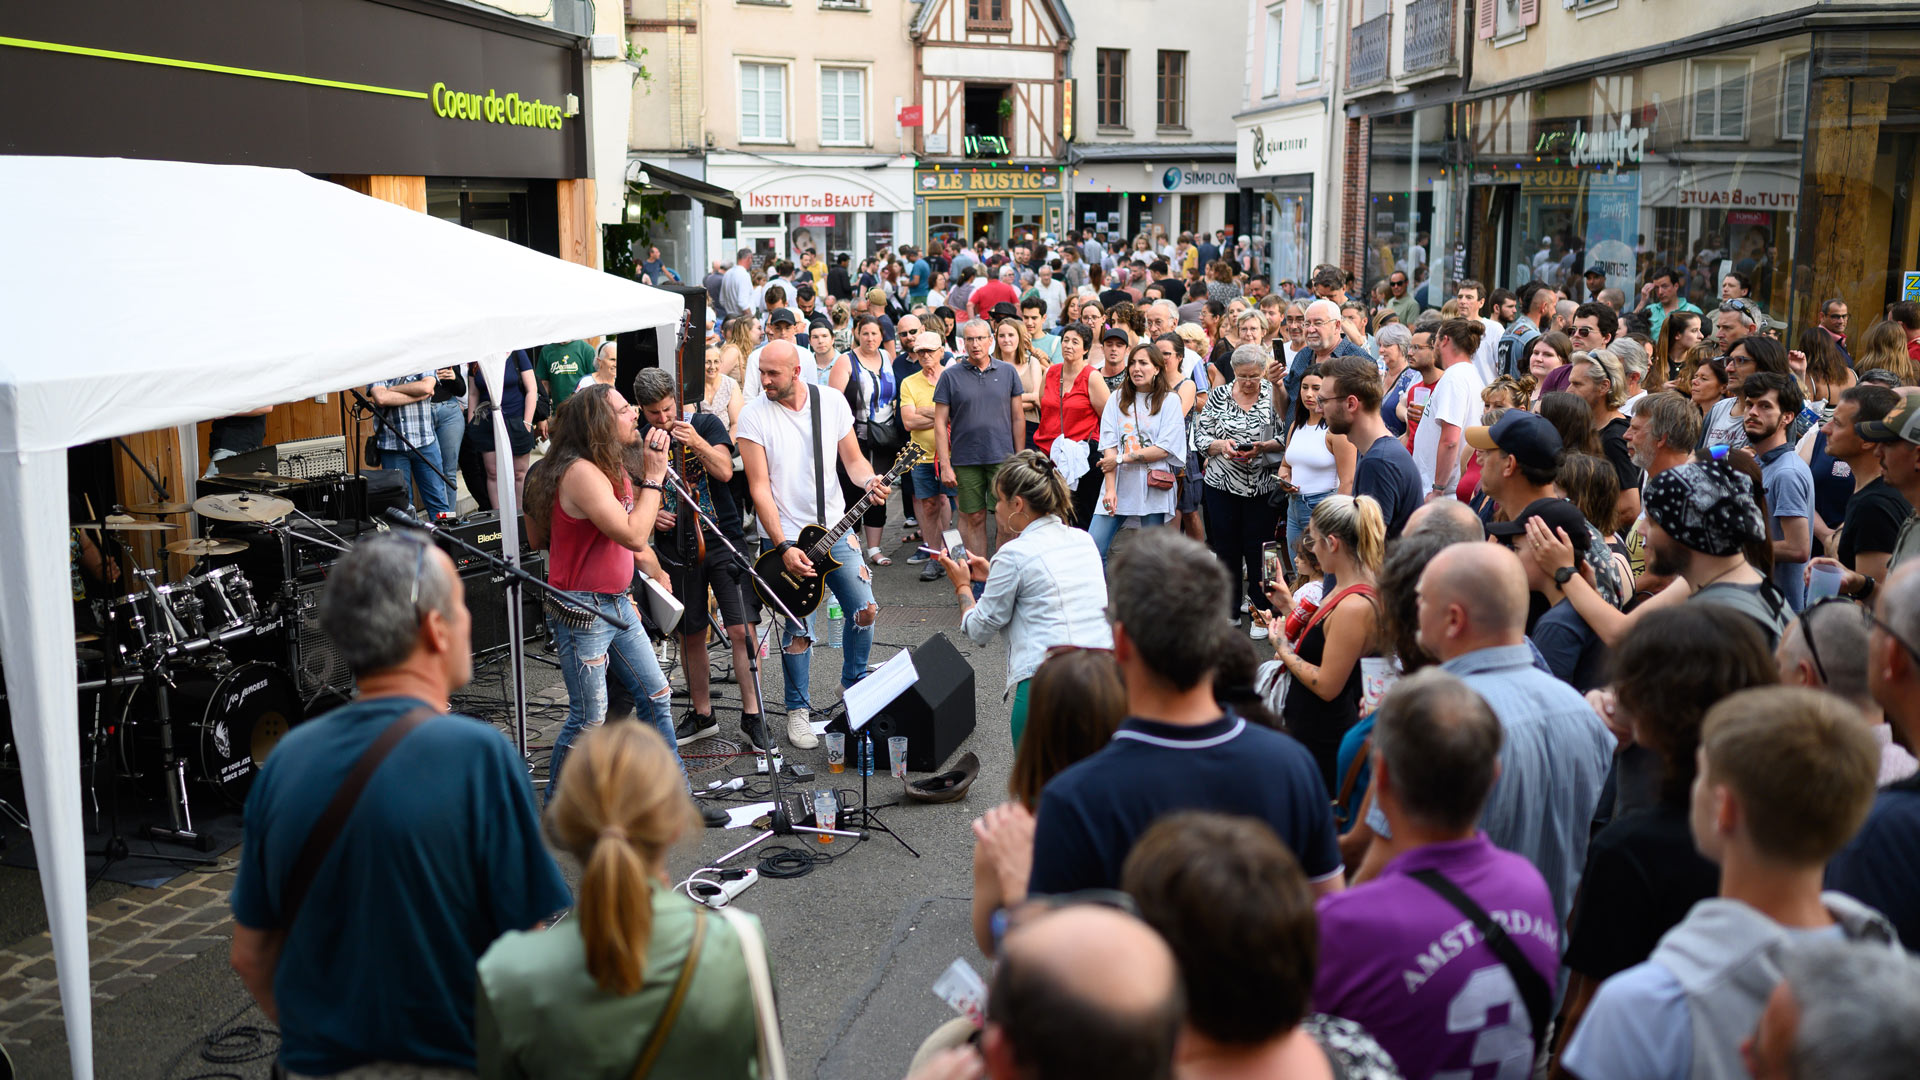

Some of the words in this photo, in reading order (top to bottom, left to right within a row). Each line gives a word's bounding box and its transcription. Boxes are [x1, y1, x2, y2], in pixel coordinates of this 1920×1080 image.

[433, 82, 482, 120] Coeur
[484, 89, 504, 123] de
[505, 92, 562, 130] Chartres
[1570, 114, 1649, 175] Jennyfer
[938, 173, 963, 189] LE
[970, 173, 1041, 189] RUSTIC
[1184, 172, 1235, 185] SIMPLON
[749, 192, 809, 207] INSTITUT
[811, 199, 822, 207] DE
[824, 192, 875, 207] BEAUTÉ
[977, 198, 1001, 207] BAR
[226, 694, 239, 712] NO
[239, 679, 268, 708] REMORSE
[223, 772, 238, 782] SINCE
[1402, 908, 1558, 995] AMSTRDAM
